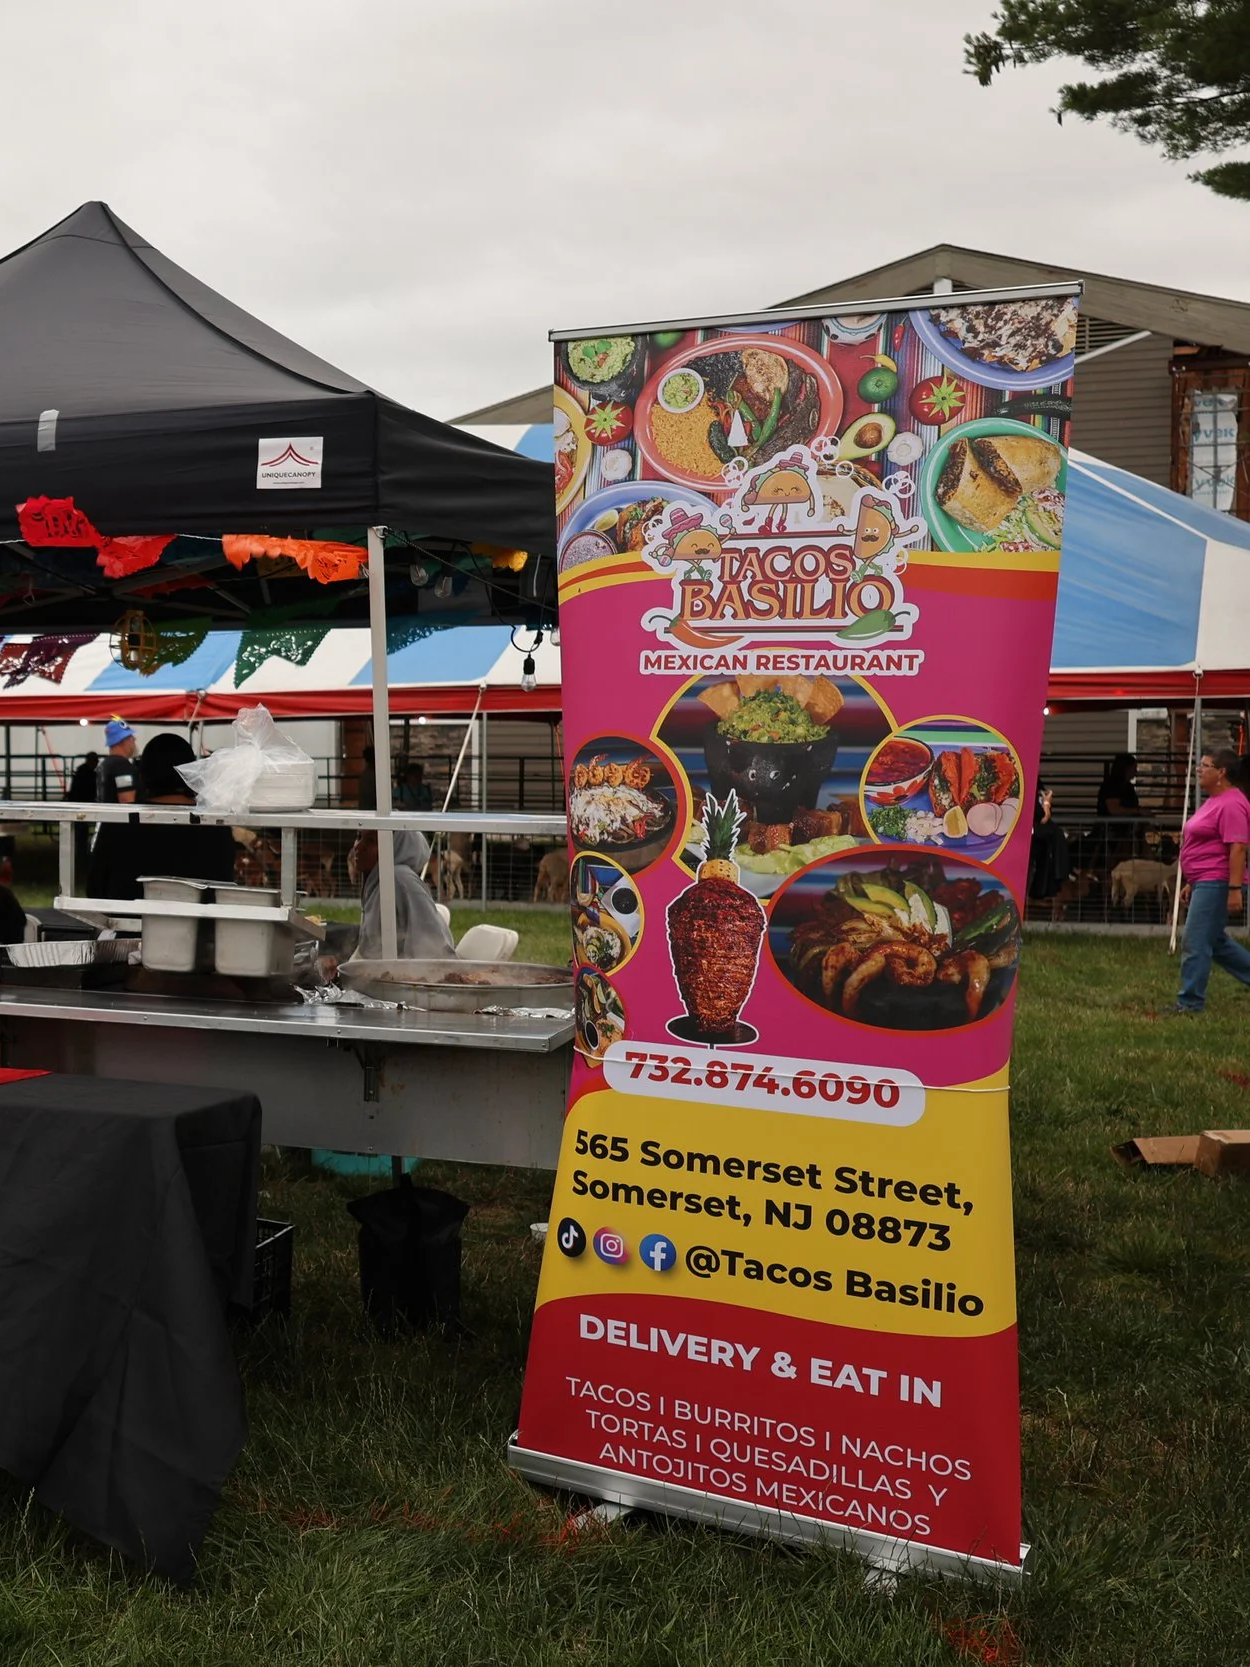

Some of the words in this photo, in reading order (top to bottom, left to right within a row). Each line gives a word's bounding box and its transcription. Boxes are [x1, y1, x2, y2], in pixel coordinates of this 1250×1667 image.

[261, 471, 316, 479] UNIQUECANOPY
[680, 574, 895, 620] BASILIO
[712, 544, 856, 582] TACOS
[643, 654, 748, 671] MEXICAN
[755, 654, 920, 672] RESTAURANT
[625, 1051, 901, 1109] 732.874.6090
[572, 1169, 752, 1227] Somerset,
[764, 1199, 812, 1231] NJ
[825, 1208, 952, 1252] 08873
[574, 1129, 630, 1163] 565
[640, 1140, 822, 1190] Somerset
[834, 1166, 974, 1216] Street,
[685, 1244, 833, 1292] @Tacos
[845, 1269, 985, 1317] Basilio
[579, 1313, 761, 1371] DELIVERY
[770, 1351, 798, 1380] &
[810, 1357, 888, 1397] EAT
[900, 1375, 942, 1408] IN
[565, 1376, 651, 1411] TACOS
[674, 1399, 816, 1448] BURRITOS
[841, 1434, 972, 1481] NACHOS
[586, 1409, 687, 1449] TORTAS
[709, 1438, 912, 1500] QUESADILLAS
[928, 1486, 948, 1507] Y
[598, 1442, 747, 1493] ANTOJITOS
[755, 1477, 932, 1536] MEXICANOS
